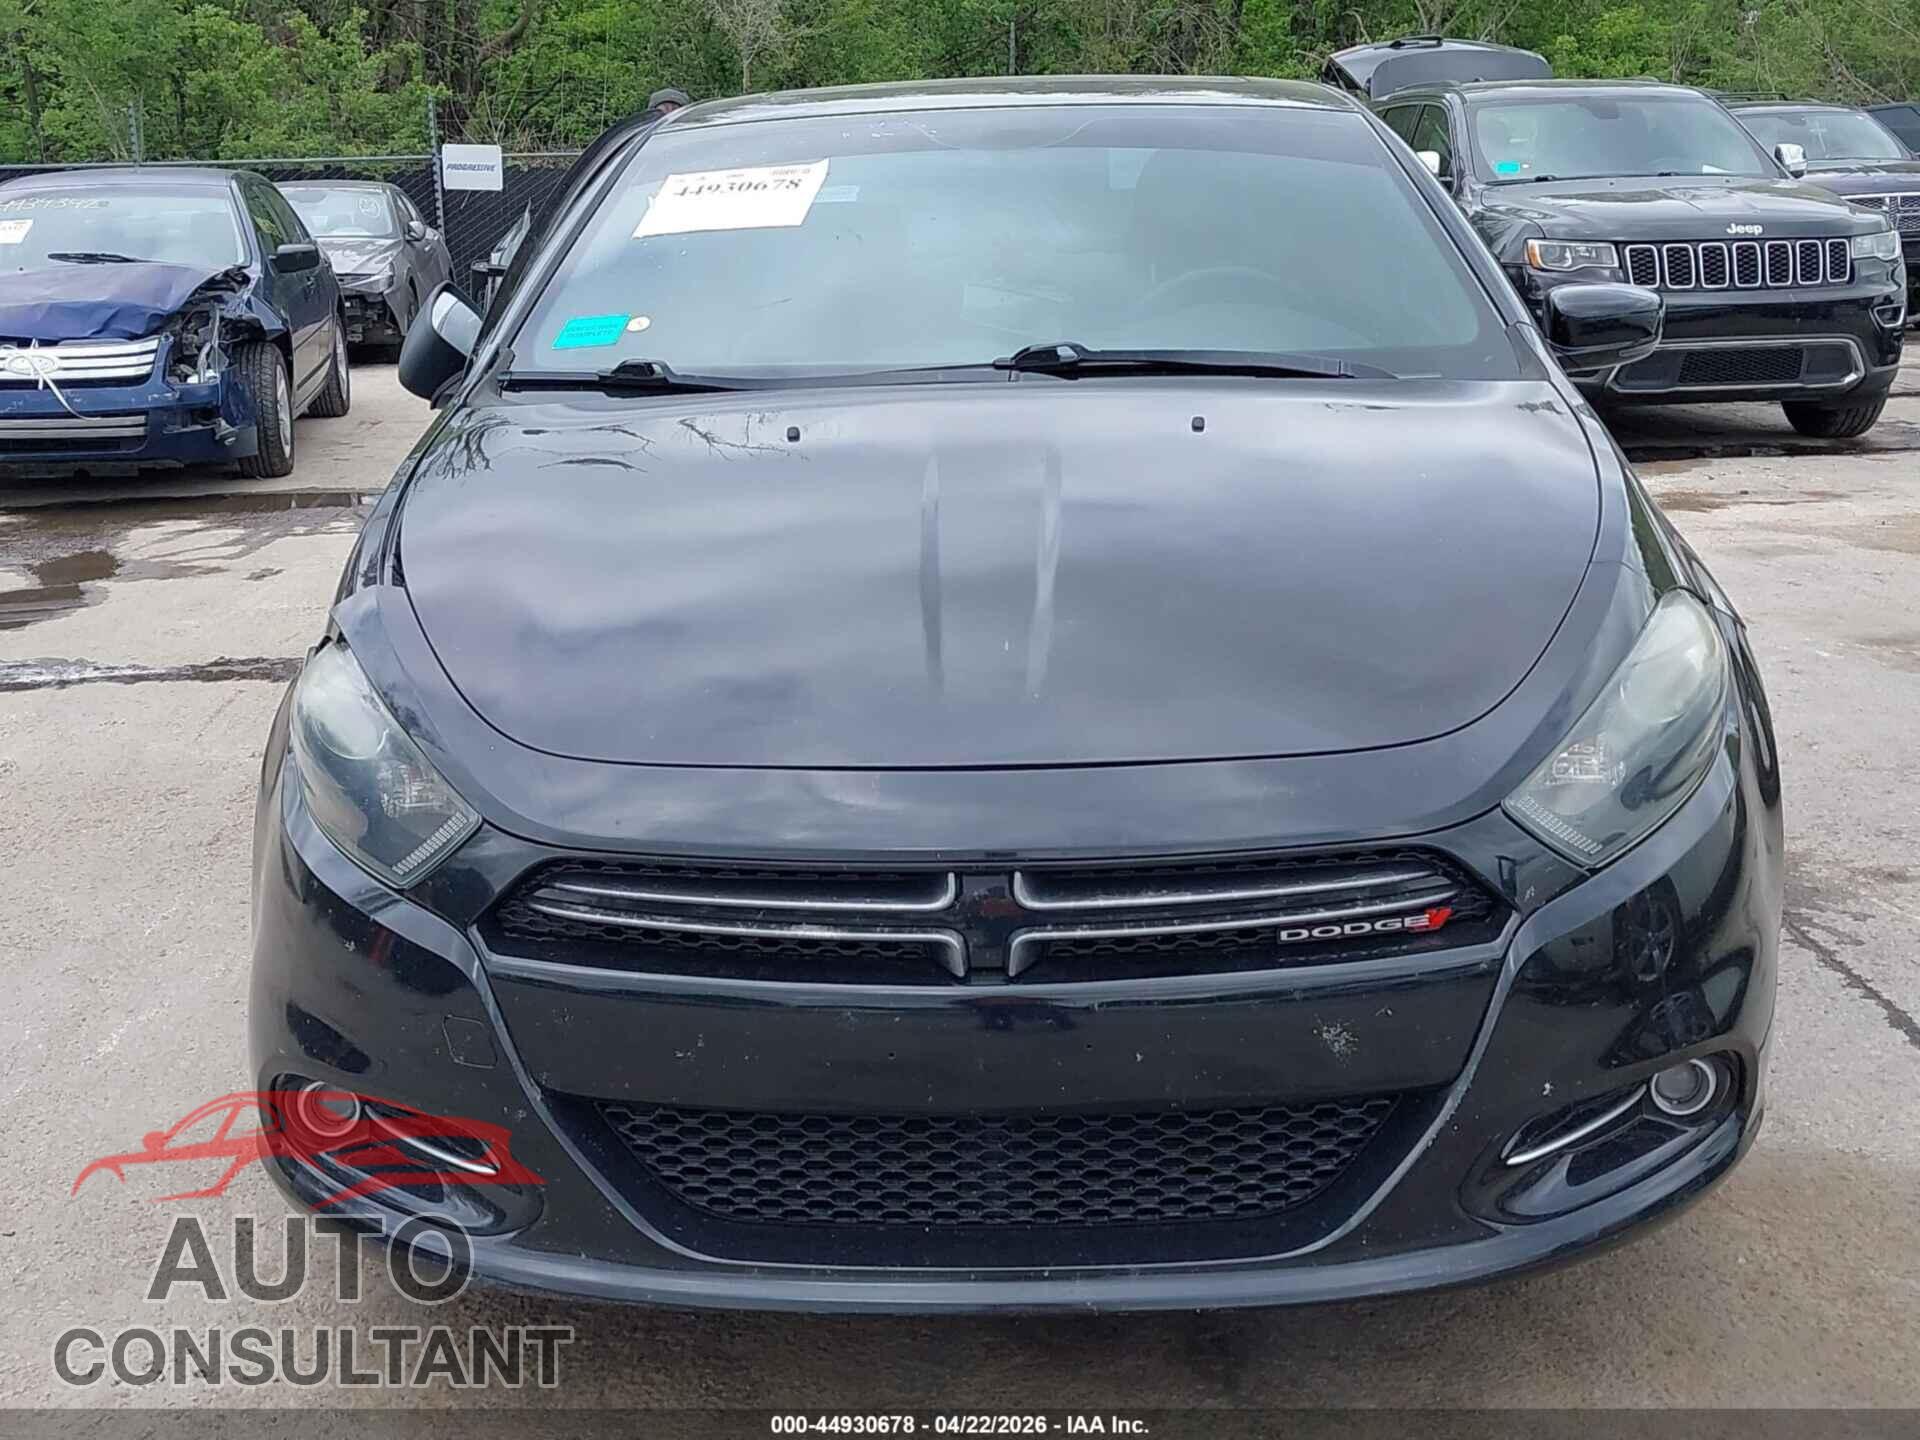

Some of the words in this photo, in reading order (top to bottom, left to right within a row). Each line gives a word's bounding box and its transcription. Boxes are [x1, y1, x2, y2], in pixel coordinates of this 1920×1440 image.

[673, 178, 803, 197] 44930678
[1726, 223, 1763, 236] Jeep
[1279, 914, 1430, 941] DODGE
